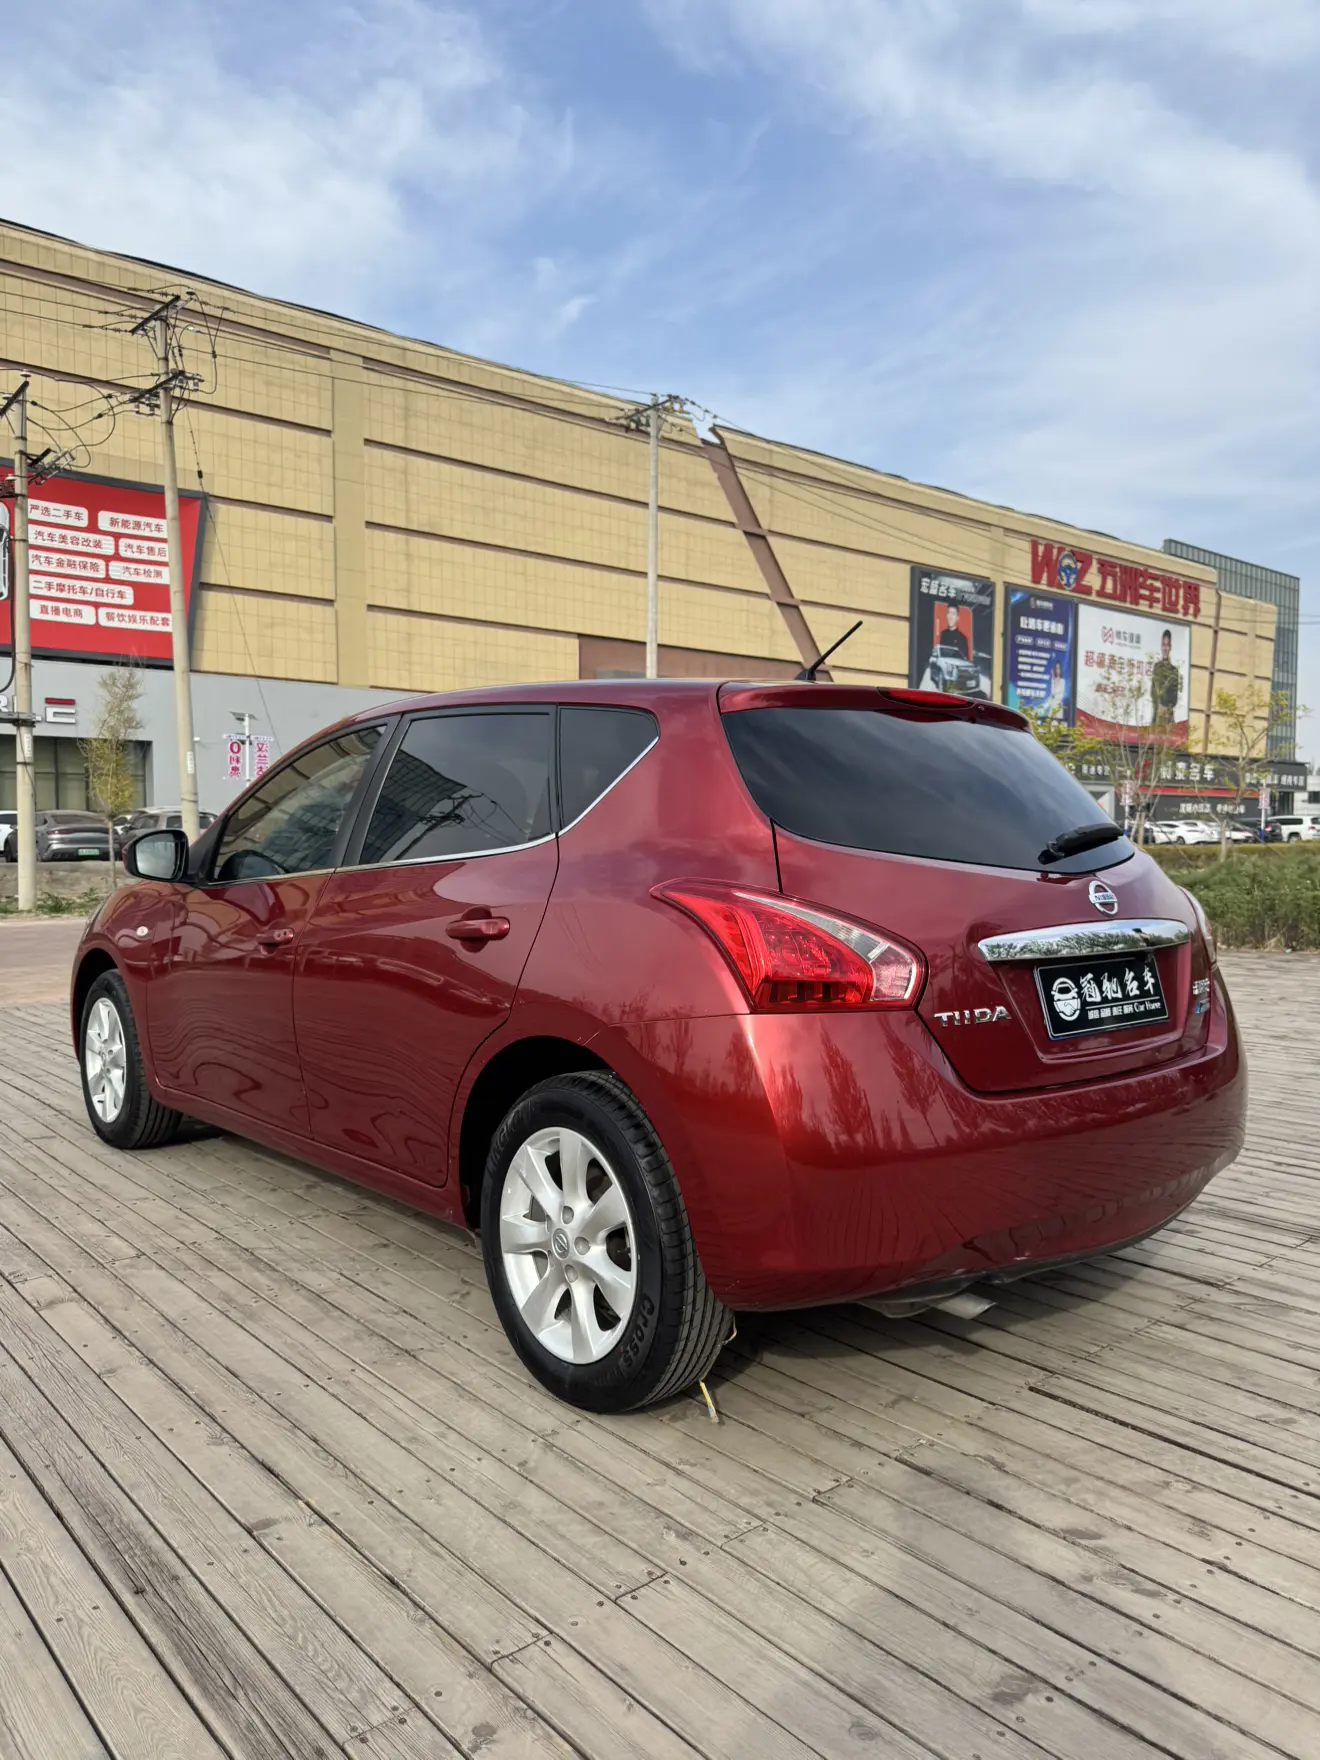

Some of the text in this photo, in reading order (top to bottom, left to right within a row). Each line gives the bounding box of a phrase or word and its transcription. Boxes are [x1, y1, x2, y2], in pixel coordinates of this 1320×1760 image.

[29, 503, 84, 522] 严选二手车
[109, 516, 164, 534] 新能源汽车
[34, 529, 103, 550] 汽车美容改装
[124, 542, 168, 558] 汽车售后
[31, 553, 100, 573] 汽车金融保险
[122, 565, 163, 580] 汽车检测
[33, 579, 127, 602] 二手摩托车/自行车
[1095, 558, 1202, 618] 五洲车世界
[39, 604, 84, 620] 直播电商
[105, 611, 171, 627] 餐饮娱乐配套
[933, 1005, 1013, 1028] TIIDA
[1134, 1003, 1145, 1013] Car
